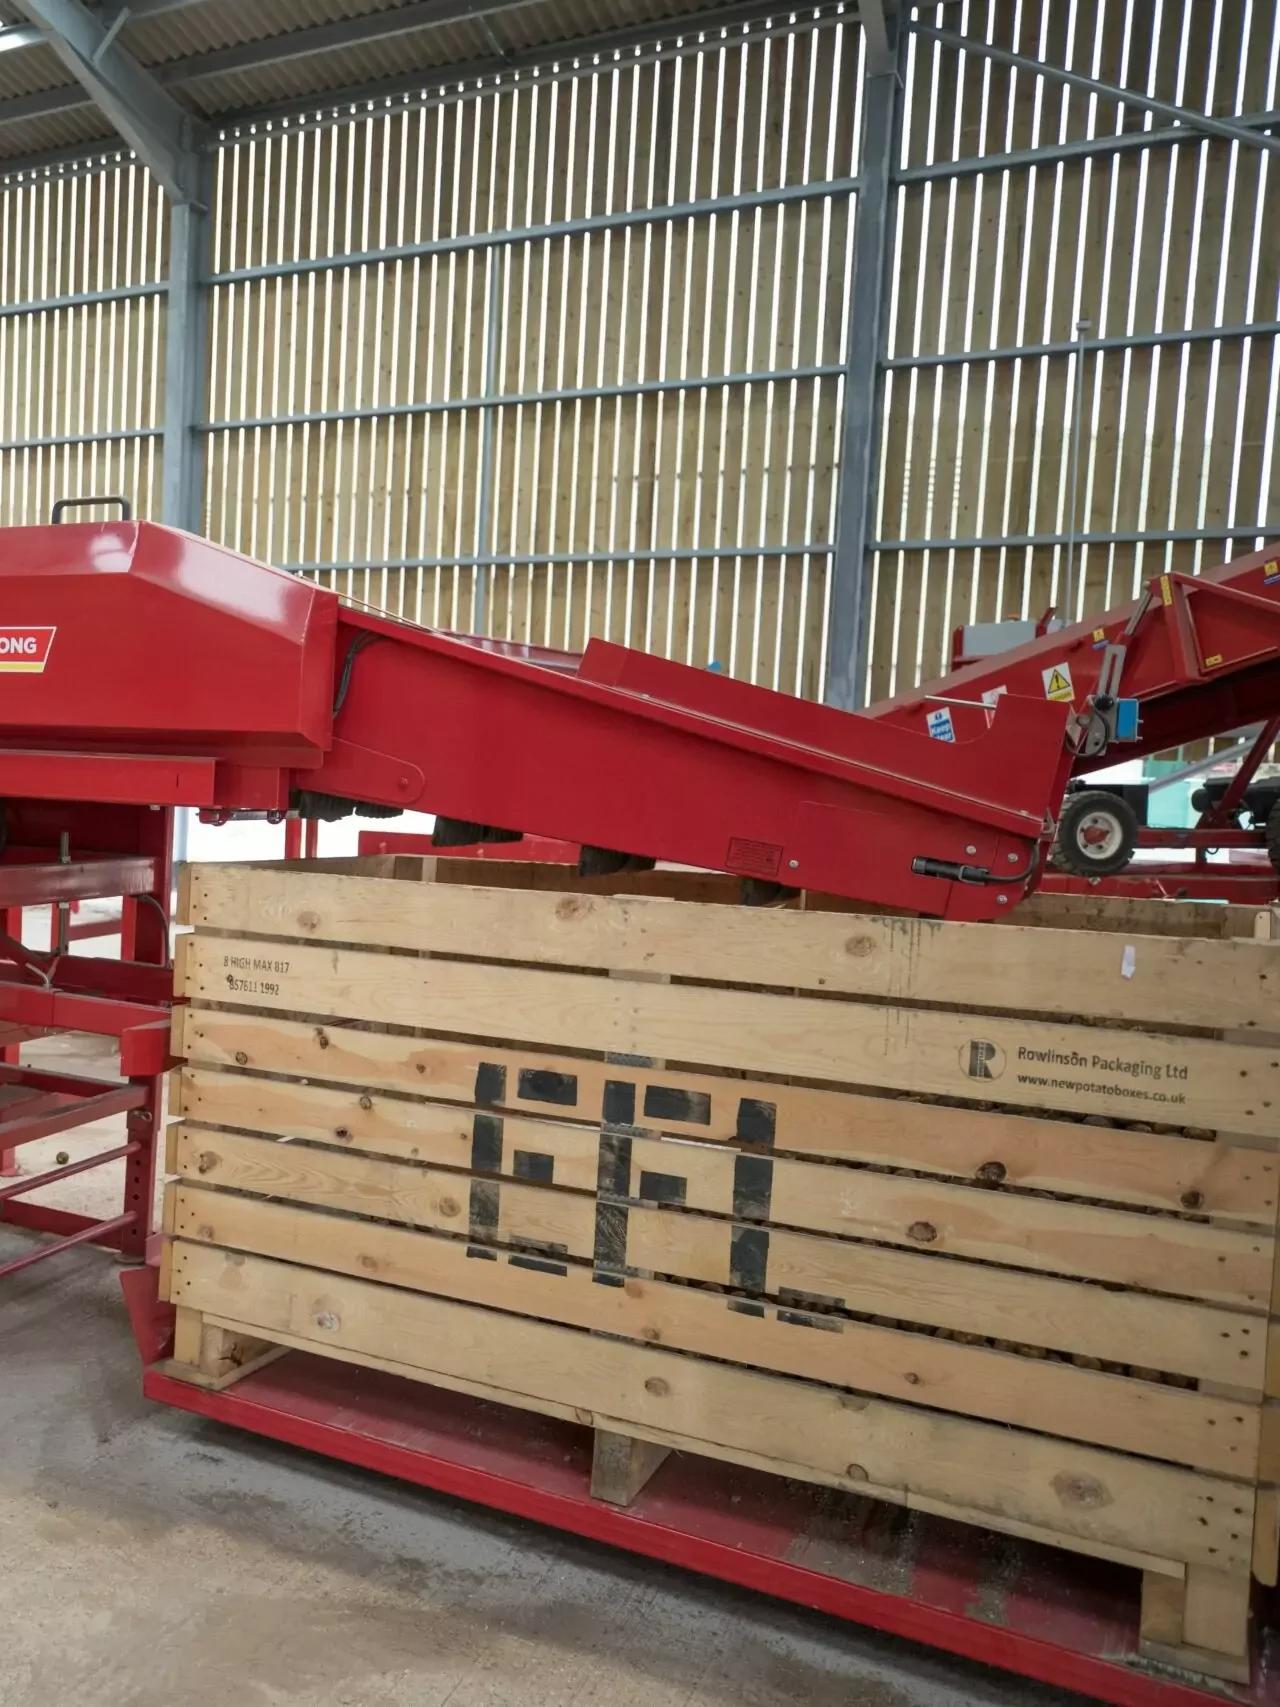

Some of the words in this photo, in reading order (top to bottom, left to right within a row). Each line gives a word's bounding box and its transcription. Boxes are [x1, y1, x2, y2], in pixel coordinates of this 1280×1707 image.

[230, 956, 251, 970] HIGH
[253, 958, 273, 973] MAX
[1018, 1046, 1088, 1068] Rowlinson
[1091, 1055, 1161, 1080] Packaging
[1166, 1064, 1188, 1080] Ltd
[1017, 1074, 1186, 1105] www.newpotatoboxes.co.uk
